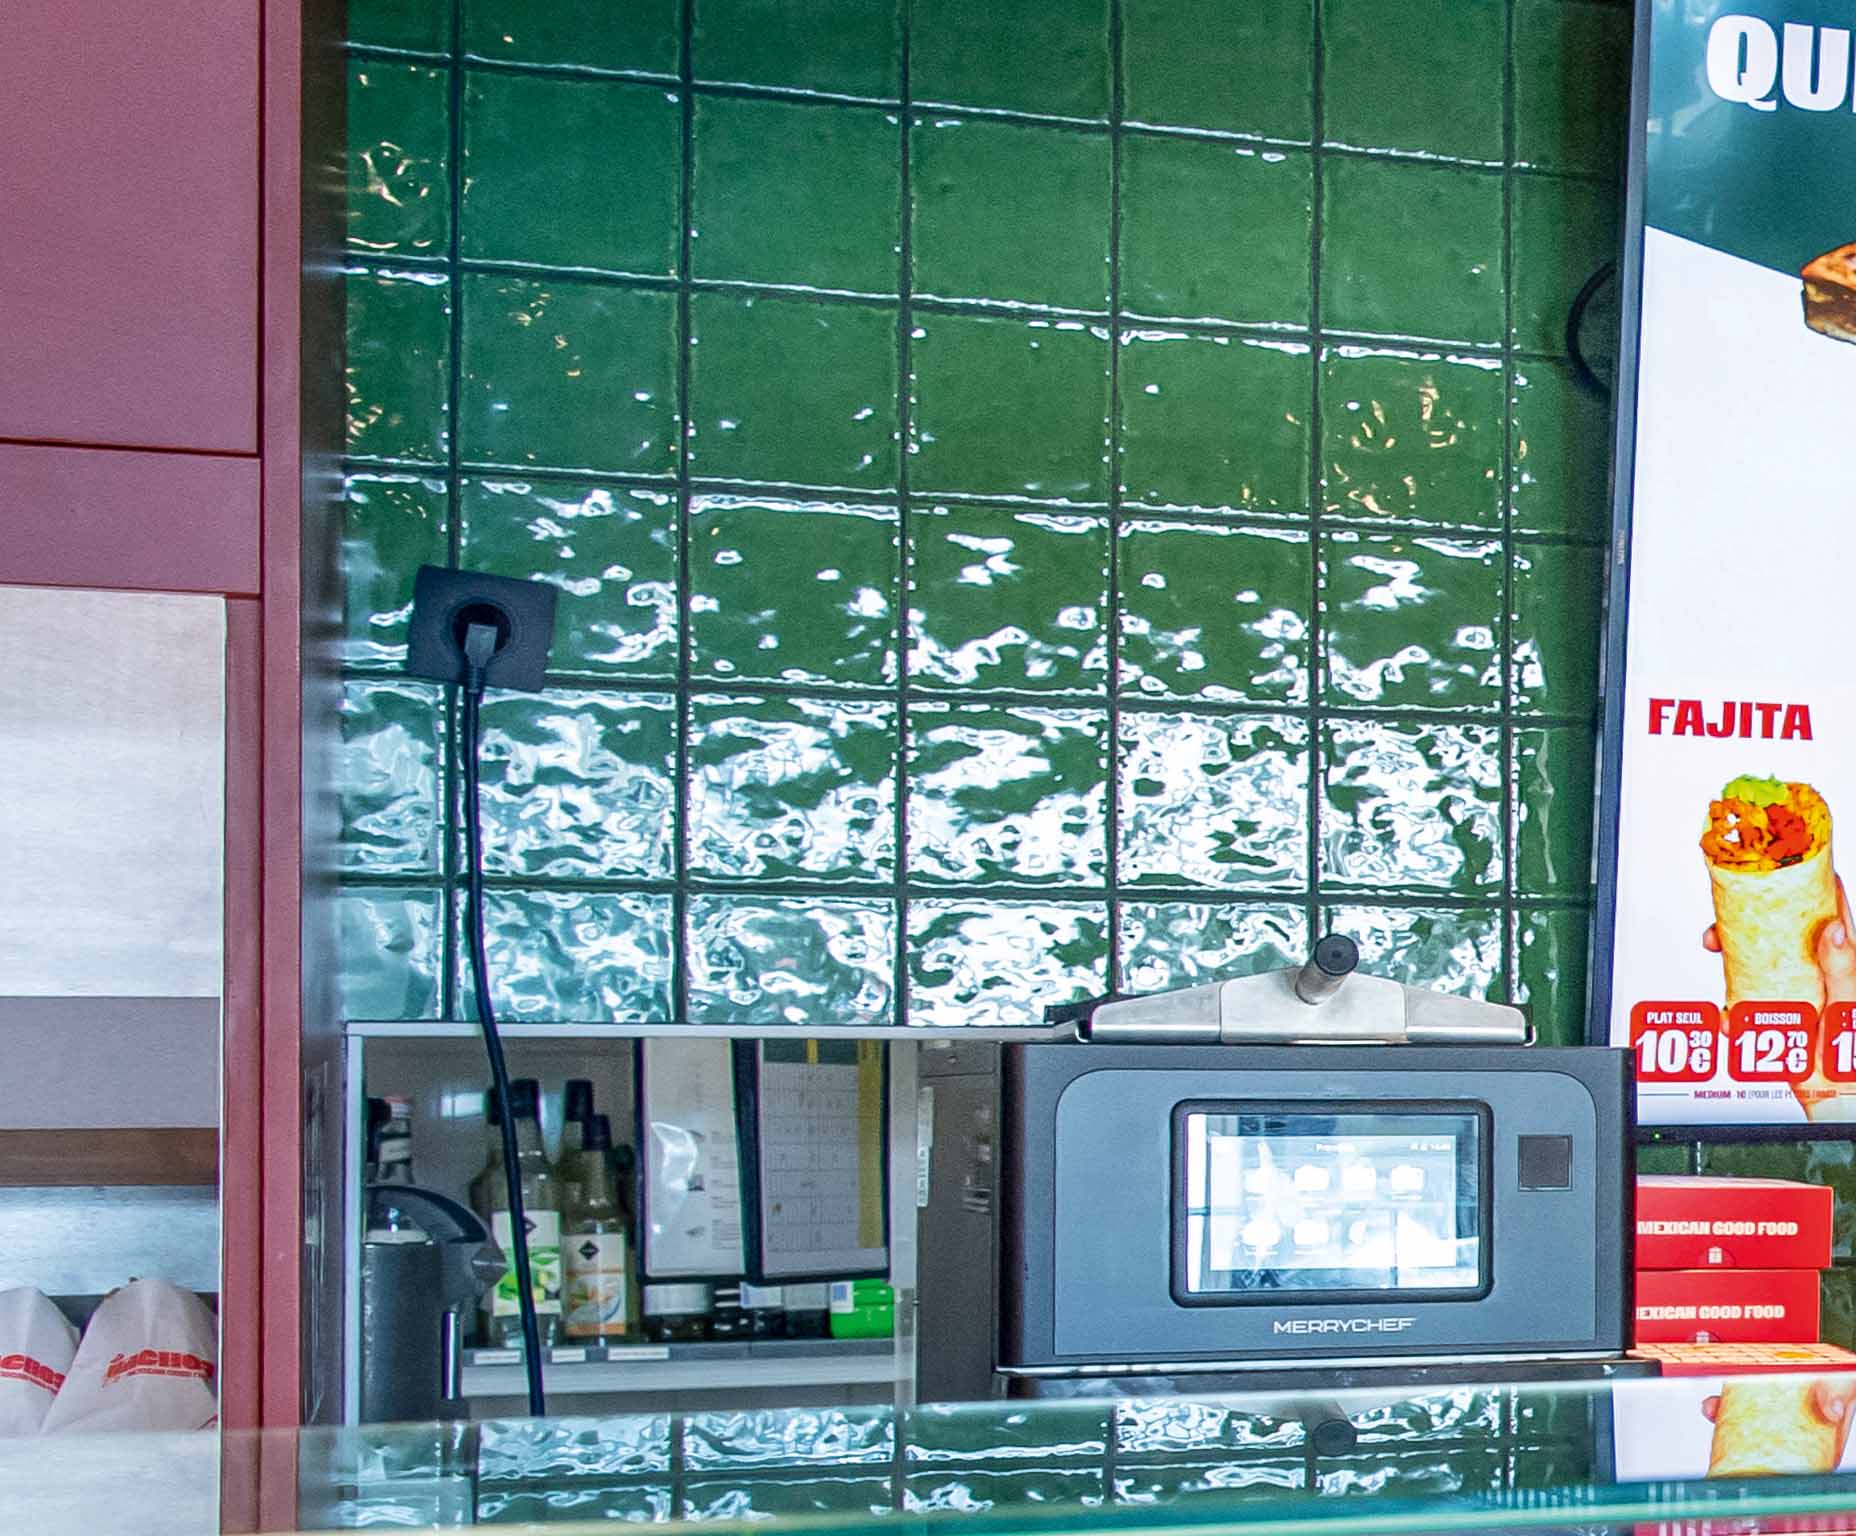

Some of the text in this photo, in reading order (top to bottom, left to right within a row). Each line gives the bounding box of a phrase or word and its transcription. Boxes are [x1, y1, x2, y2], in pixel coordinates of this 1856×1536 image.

[1648, 698, 1813, 741] FAJITA
[1647, 1012, 1703, 1025] PLAT SEUL
[1635, 1029, 1689, 1073] 10
[1735, 1029, 1786, 1073] 12
[1637, 1221, 1798, 1235] MEXICAN GOOD FOOD
[1699, 1306, 1742, 1319] GOOD
[1744, 1305, 1785, 1319] FOOD
[1274, 1318, 1418, 1333] MERRYCHEF
